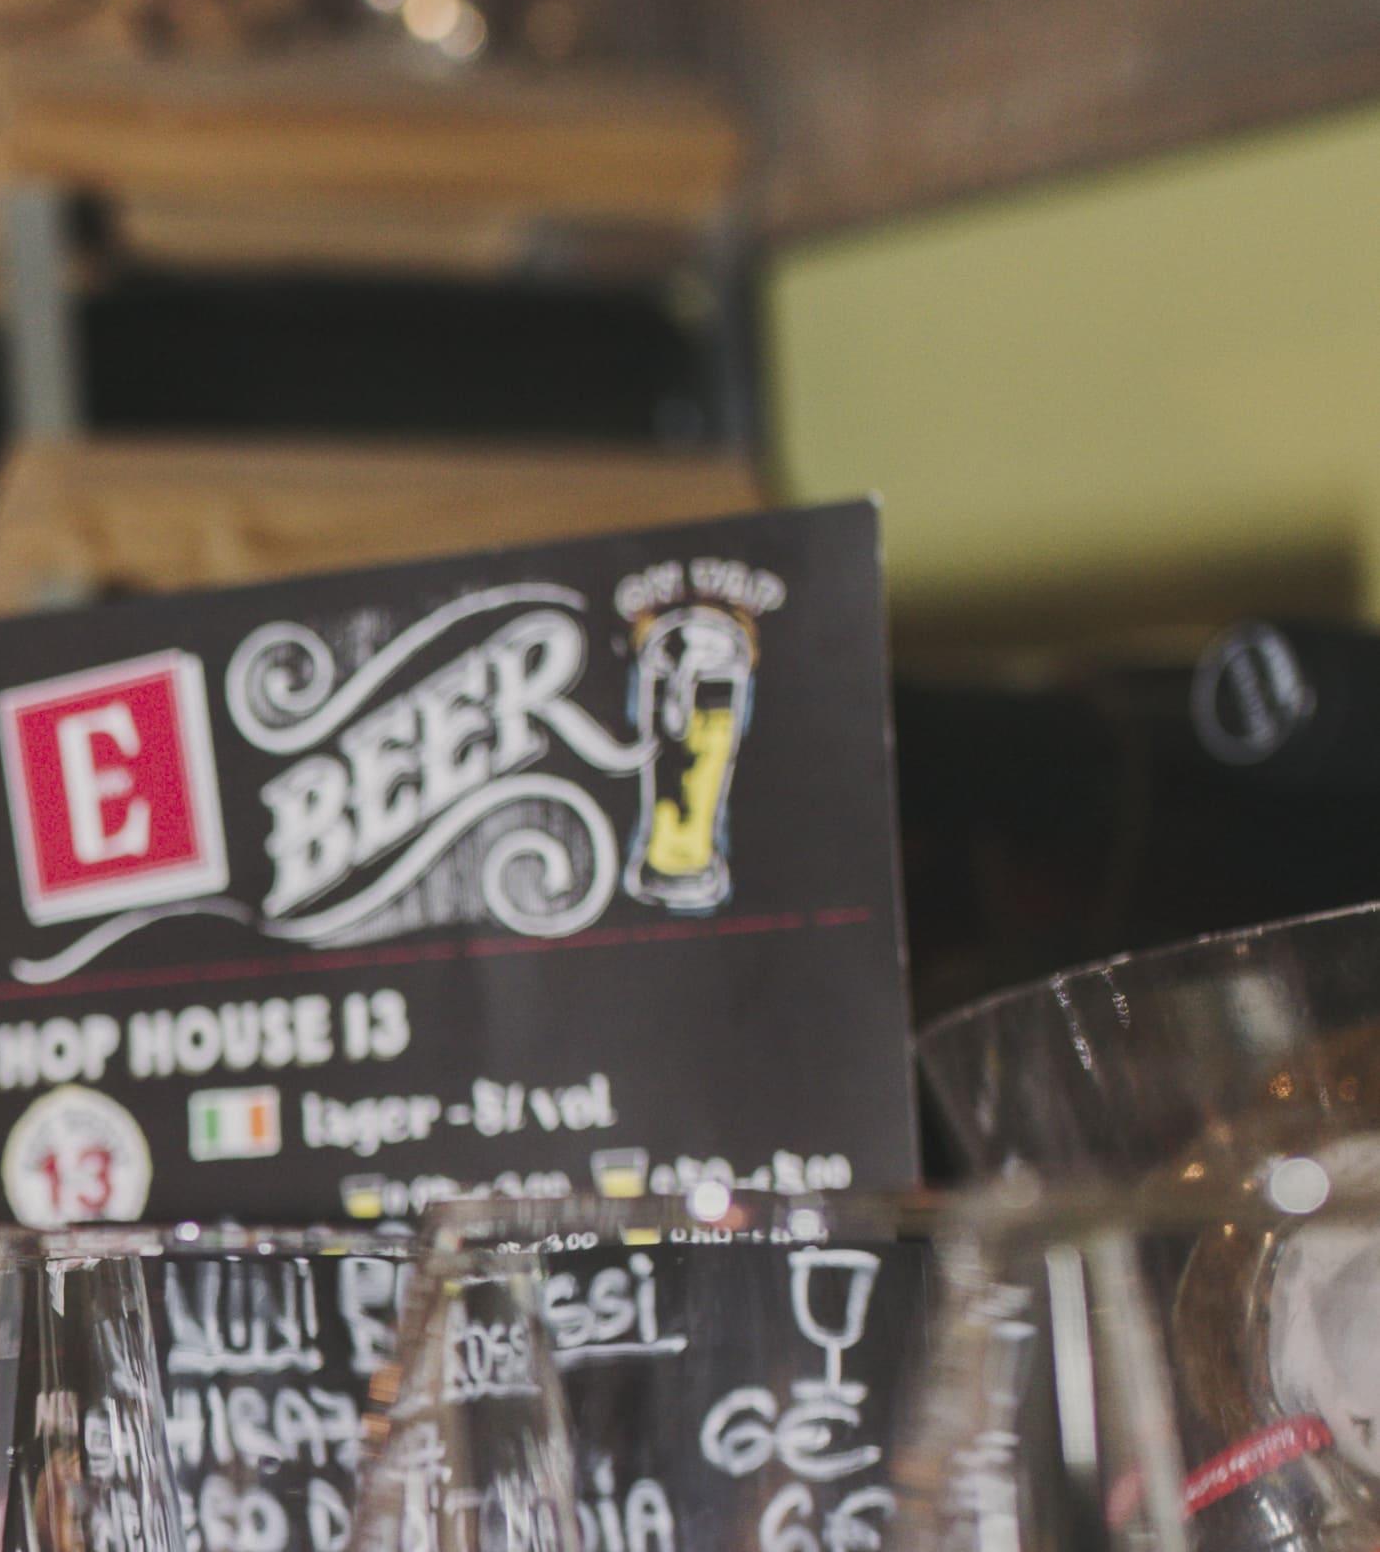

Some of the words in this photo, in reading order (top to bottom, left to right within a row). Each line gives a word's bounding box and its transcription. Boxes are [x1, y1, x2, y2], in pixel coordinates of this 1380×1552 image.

[55, 701, 151, 866] E
[261, 608, 657, 920] BEER
[129, 995, 332, 1079] HOUSE
[342, 989, 410, 1058] 13
[38, 1146, 114, 1214] 13
